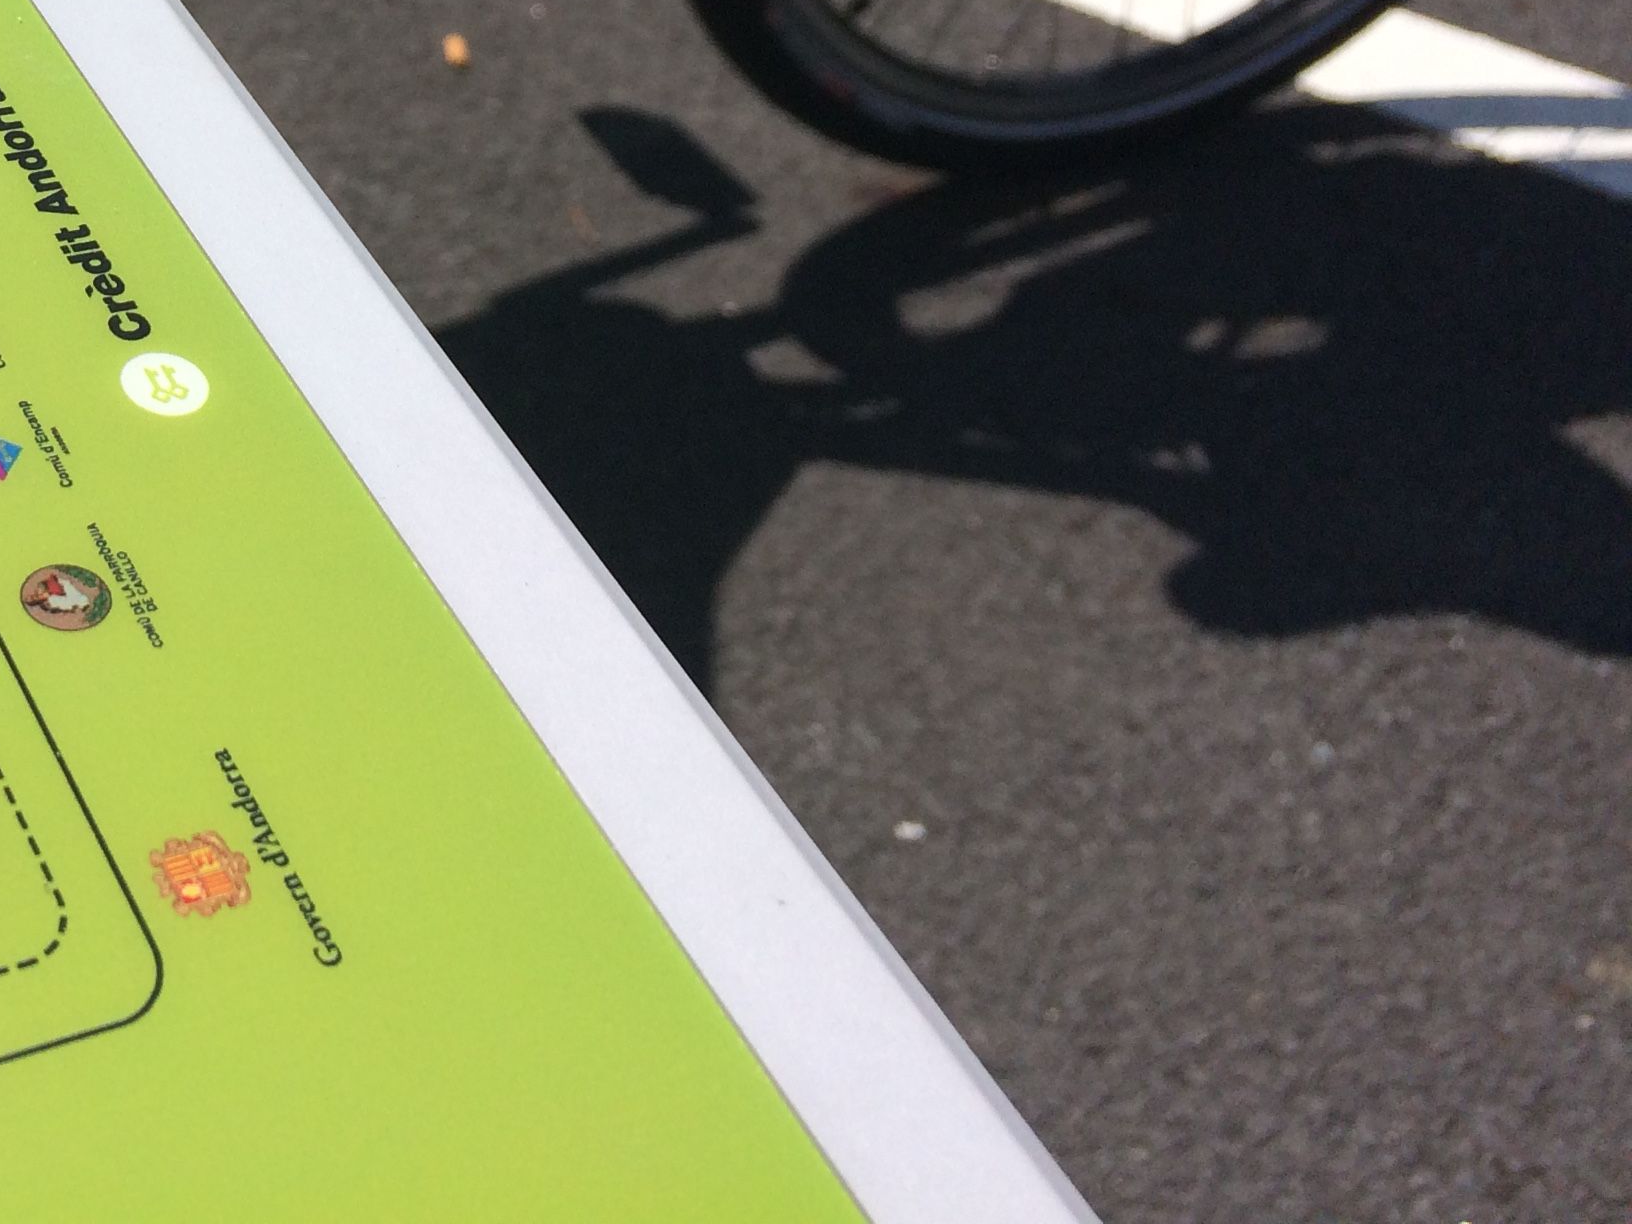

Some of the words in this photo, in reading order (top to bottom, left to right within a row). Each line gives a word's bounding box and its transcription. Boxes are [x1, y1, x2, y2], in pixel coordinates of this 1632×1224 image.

[54, 224, 151, 341] Crèdit
[18, 400, 54, 453] d'Encamp
[45, 454, 73, 487] Comú
[116, 551, 148, 595] CANILLO
[121, 584, 136, 599] LA
[129, 599, 145, 615] DE
[142, 597, 158, 612] DE
[215, 747, 289, 867] d'Andorra
[284, 872, 342, 966] Govern
